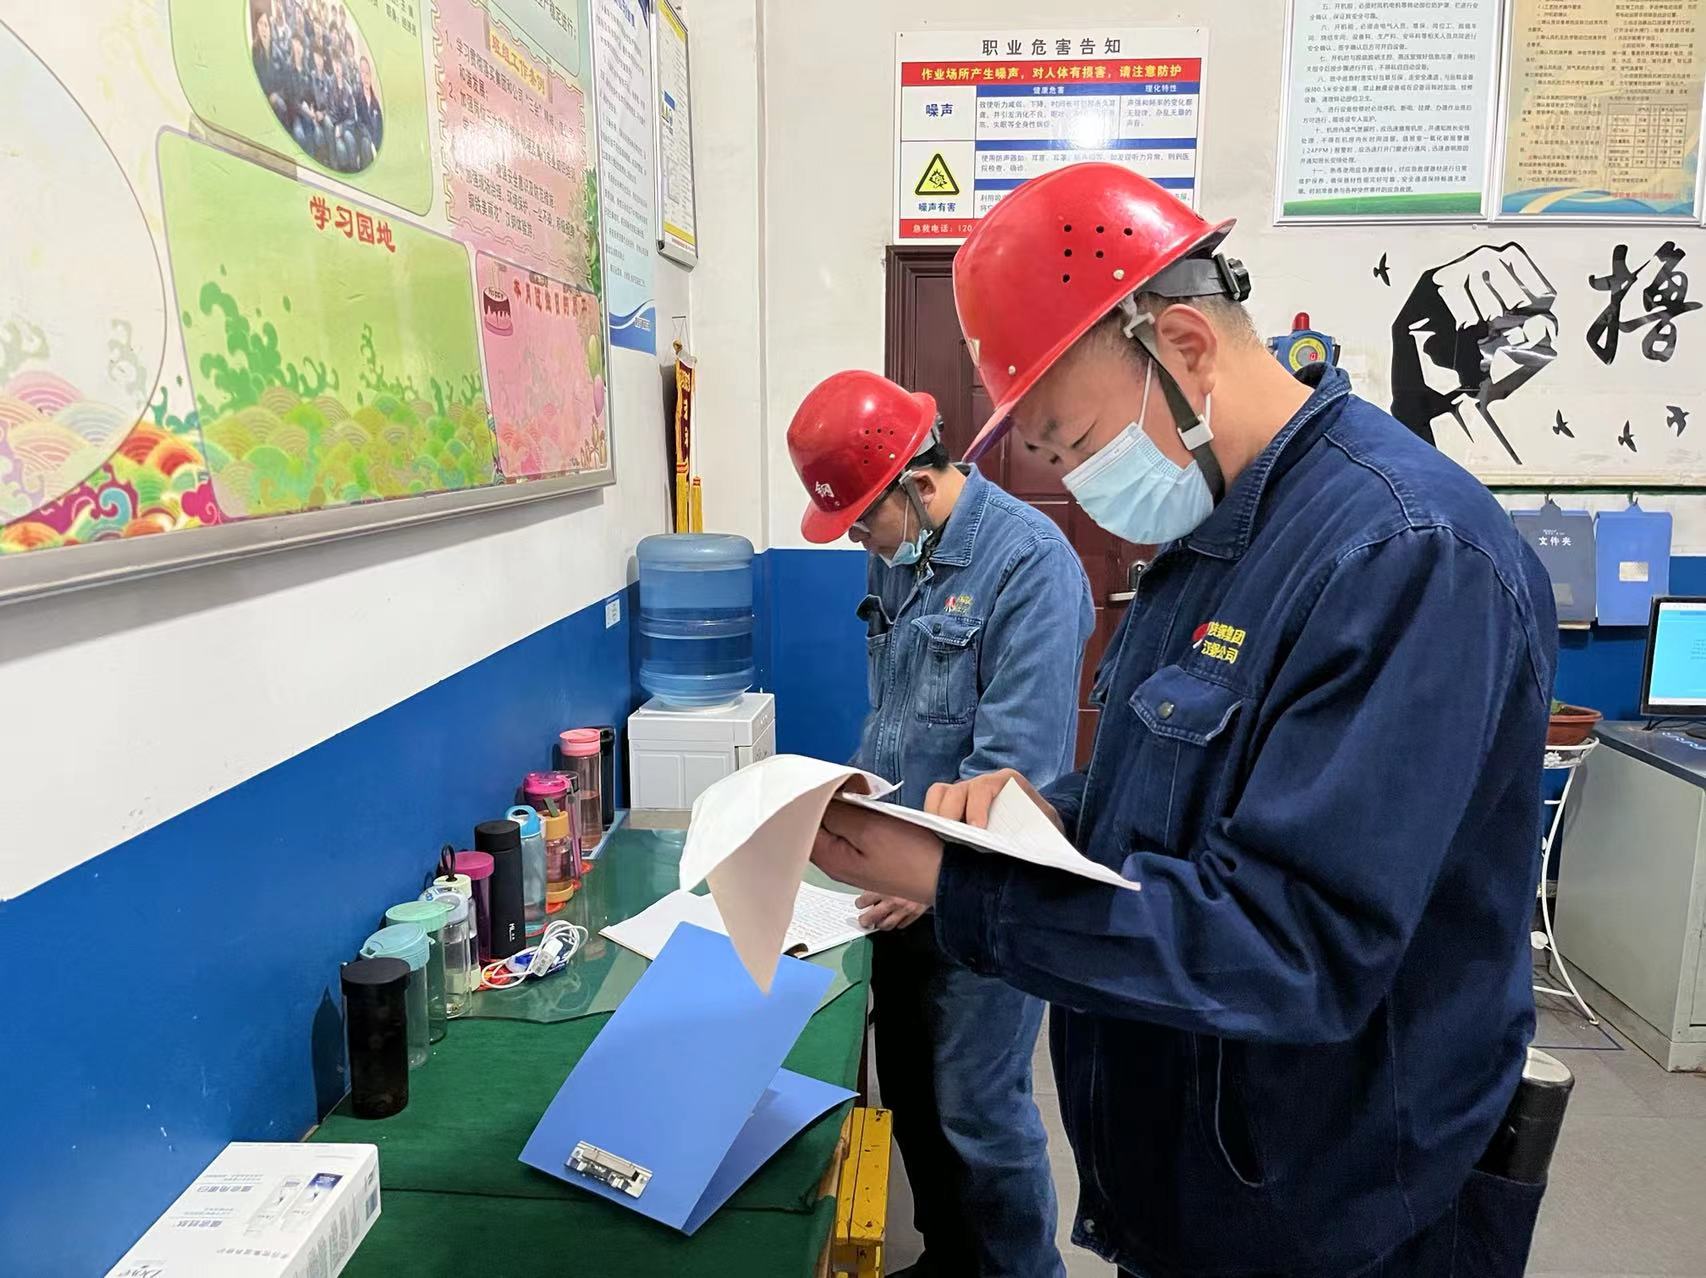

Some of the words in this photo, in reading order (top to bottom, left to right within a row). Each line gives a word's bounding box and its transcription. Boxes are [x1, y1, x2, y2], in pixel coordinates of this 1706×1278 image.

[982, 38, 1122, 56] 职业危害告知
[1032, 85, 1065, 95] 健康危害
[1145, 84, 1177, 93] 理化特性
[925, 103, 953, 117] 噪声
[918, 202, 956, 212] 噪声有害
[309, 195, 396, 253] 学习园地
[1586, 241, 1703, 366] 撸
[815, 480, 835, 498] 钢
[1538, 536, 1572, 546] 文件夹
